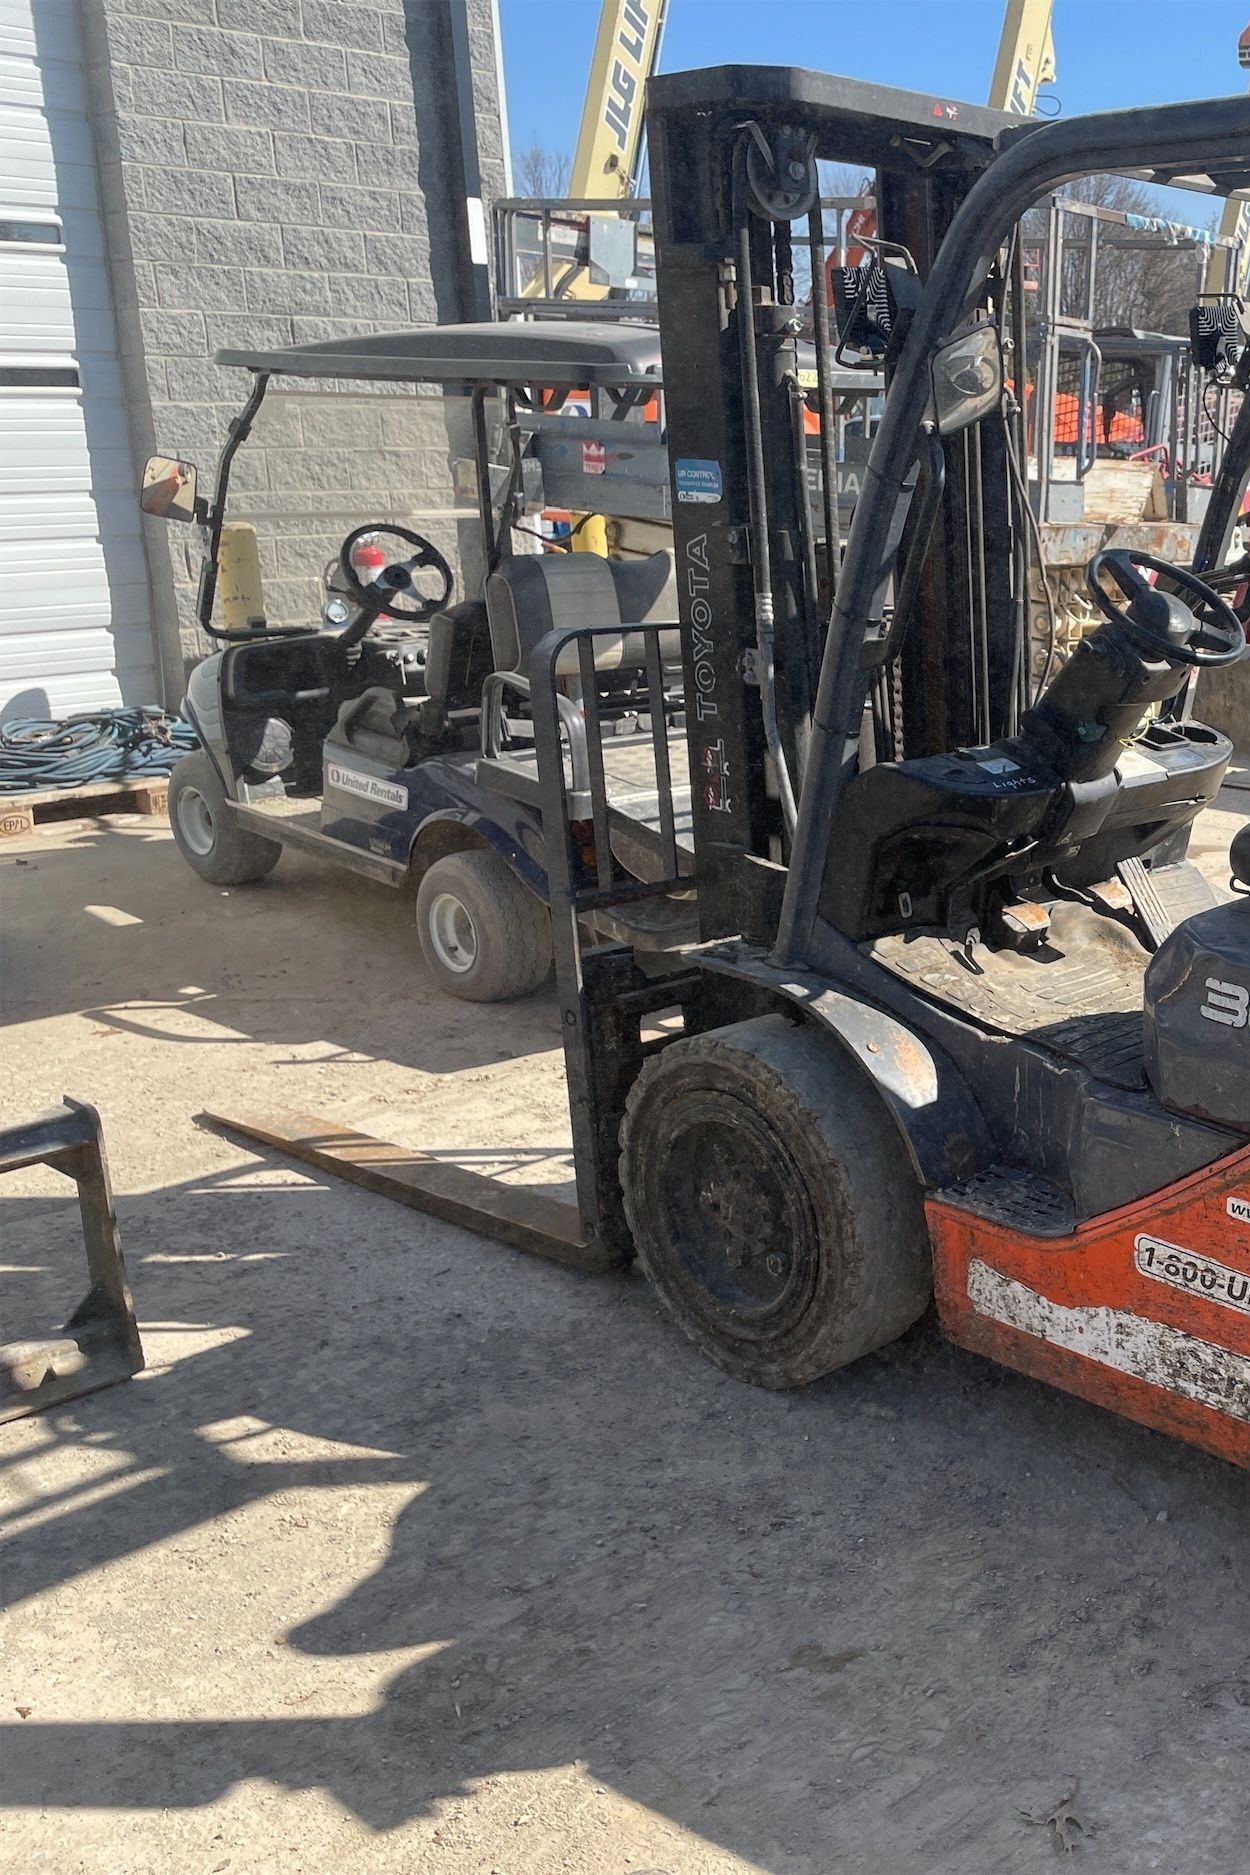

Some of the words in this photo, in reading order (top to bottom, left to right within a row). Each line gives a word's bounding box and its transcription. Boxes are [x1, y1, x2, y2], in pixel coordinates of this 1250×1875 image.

[605, 58, 636, 152] JLG
[686, 533, 718, 721] TOYOTA
[342, 772, 370, 792] United
[370, 782, 403, 803] Rentals
